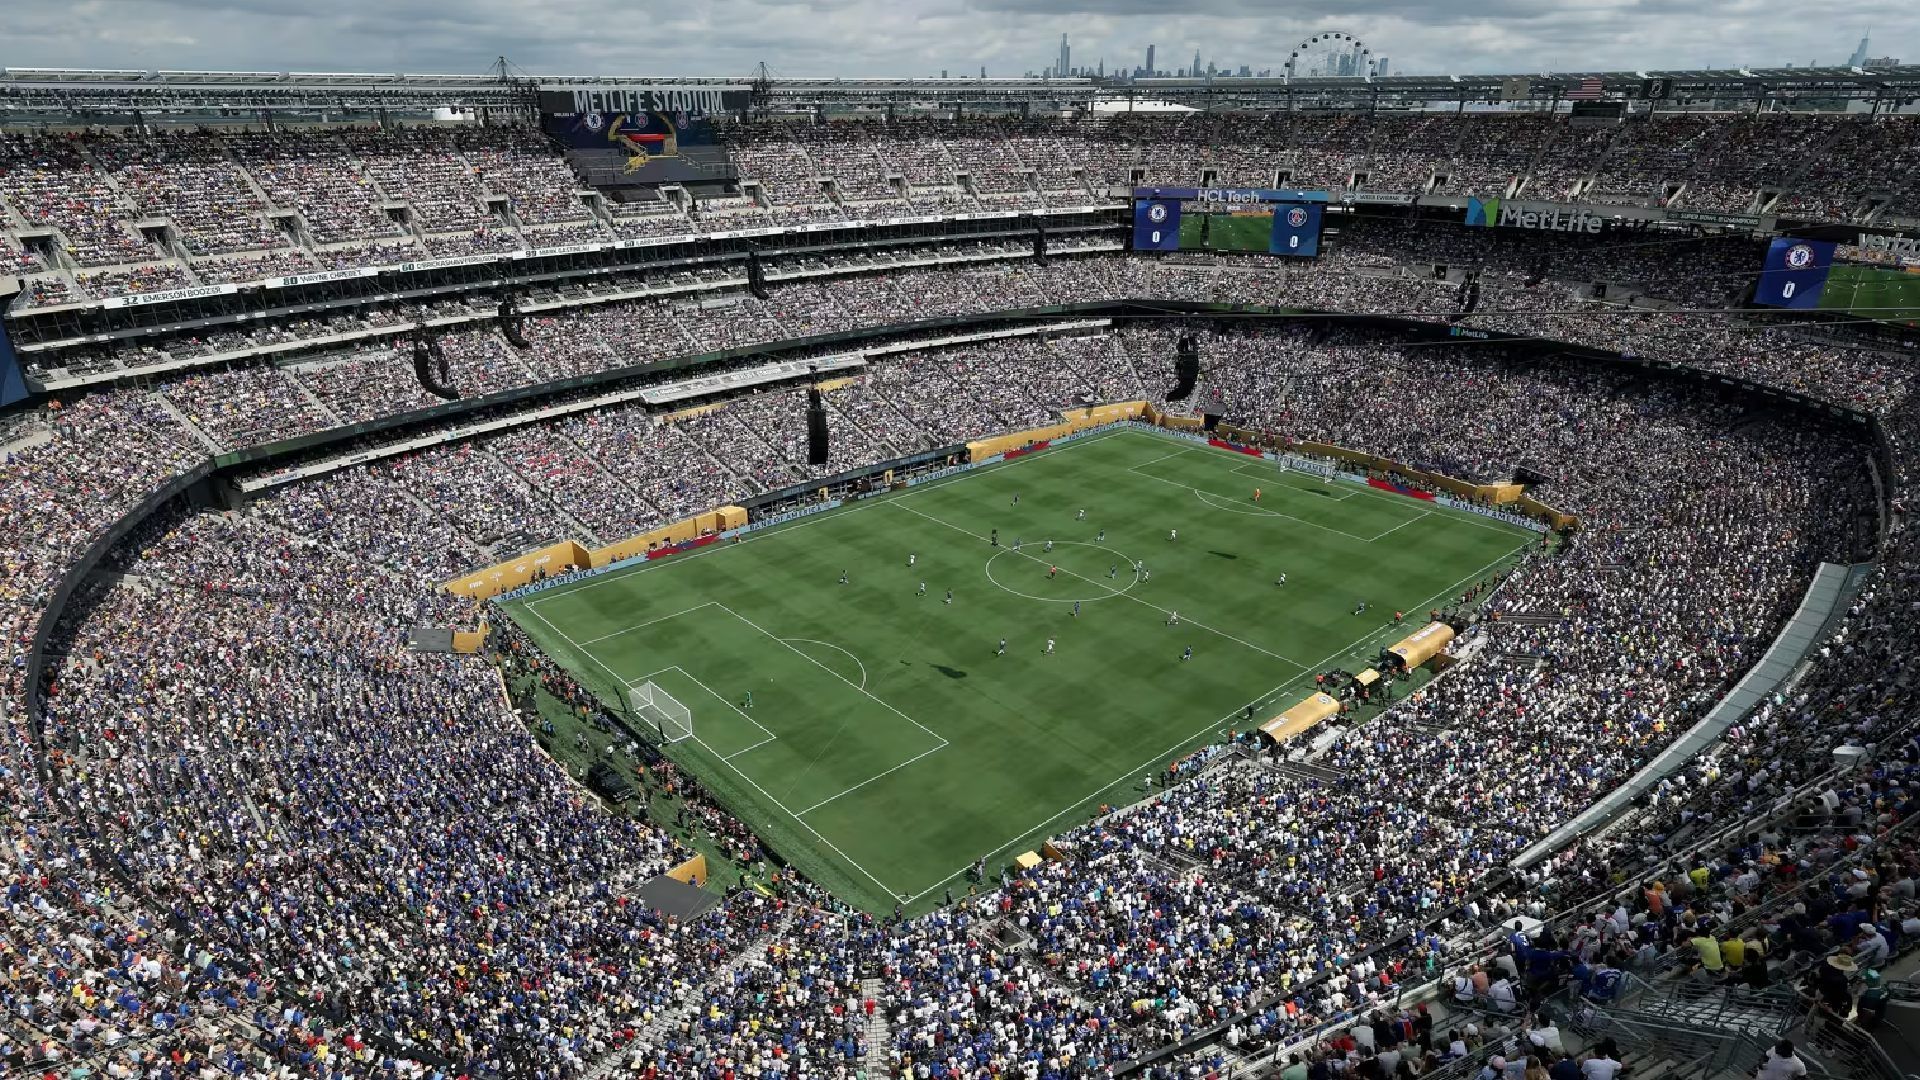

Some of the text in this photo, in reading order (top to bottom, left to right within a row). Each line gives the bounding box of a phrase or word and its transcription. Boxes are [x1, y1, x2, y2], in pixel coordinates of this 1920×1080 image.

[573, 90, 726, 113] METLIFE STADIUM
[1197, 190, 1260, 203] HCLTech
[1502, 204, 1603, 234] MetLife
[1152, 231, 1161, 243] 0
[1289, 235, 1299, 248] 0
[121, 285, 223, 306] 32 EMERSON BOOZER
[1782, 280, 1796, 298] 0
[1449, 500, 1474, 513] BANK
[1491, 511, 1533, 531] AMERICA
[501, 585, 530, 601] BANK
[549, 568, 598, 588] AMERICA
